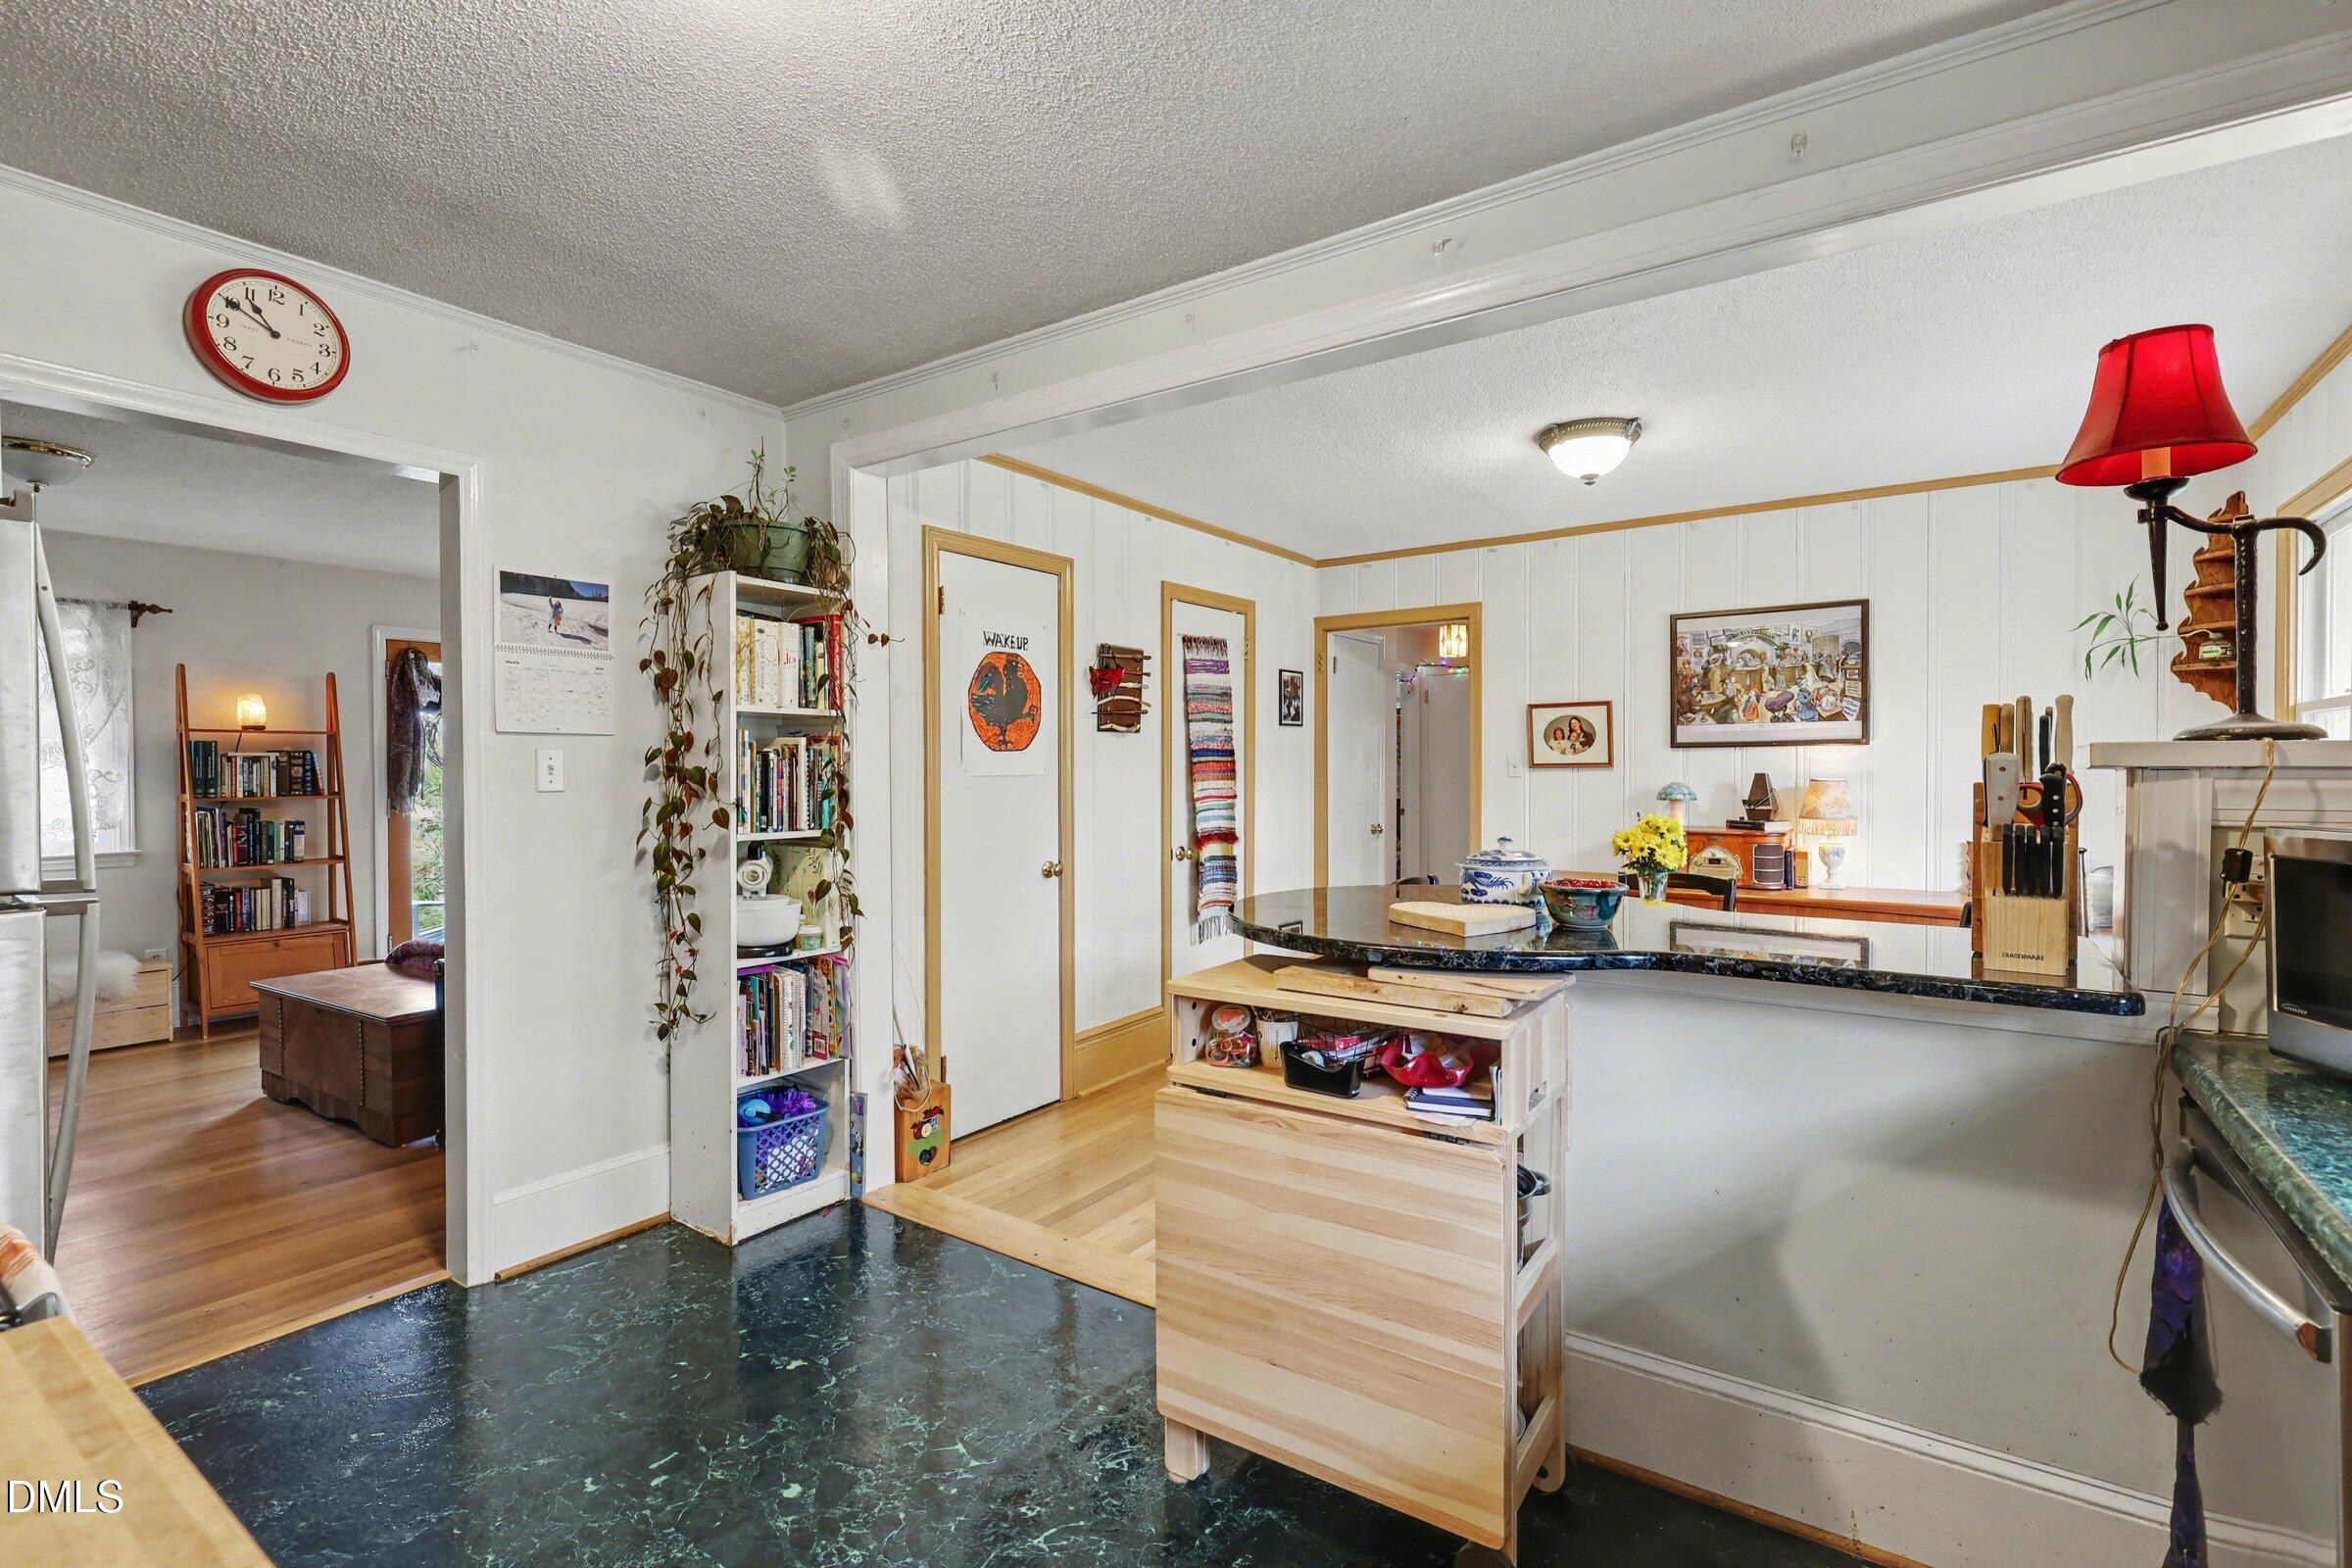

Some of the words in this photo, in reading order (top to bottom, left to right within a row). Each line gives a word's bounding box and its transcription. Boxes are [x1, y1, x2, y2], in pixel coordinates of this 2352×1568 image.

[245, 287, 255, 302] 11
[269, 288, 285, 306] 12
[299, 304, 304, 317] 1
[216, 314, 230, 328] 9
[313, 322, 325, 337] 2
[223, 336, 237, 352] 8
[318, 343, 331, 358] 3
[241, 355, 255, 369] 7
[310, 361, 320, 375] 4
[268, 368, 281, 382] 6
[292, 368, 305, 383] 5
[983, 631, 1015, 649] WAKE
[1017, 636, 1029, 651] UP
